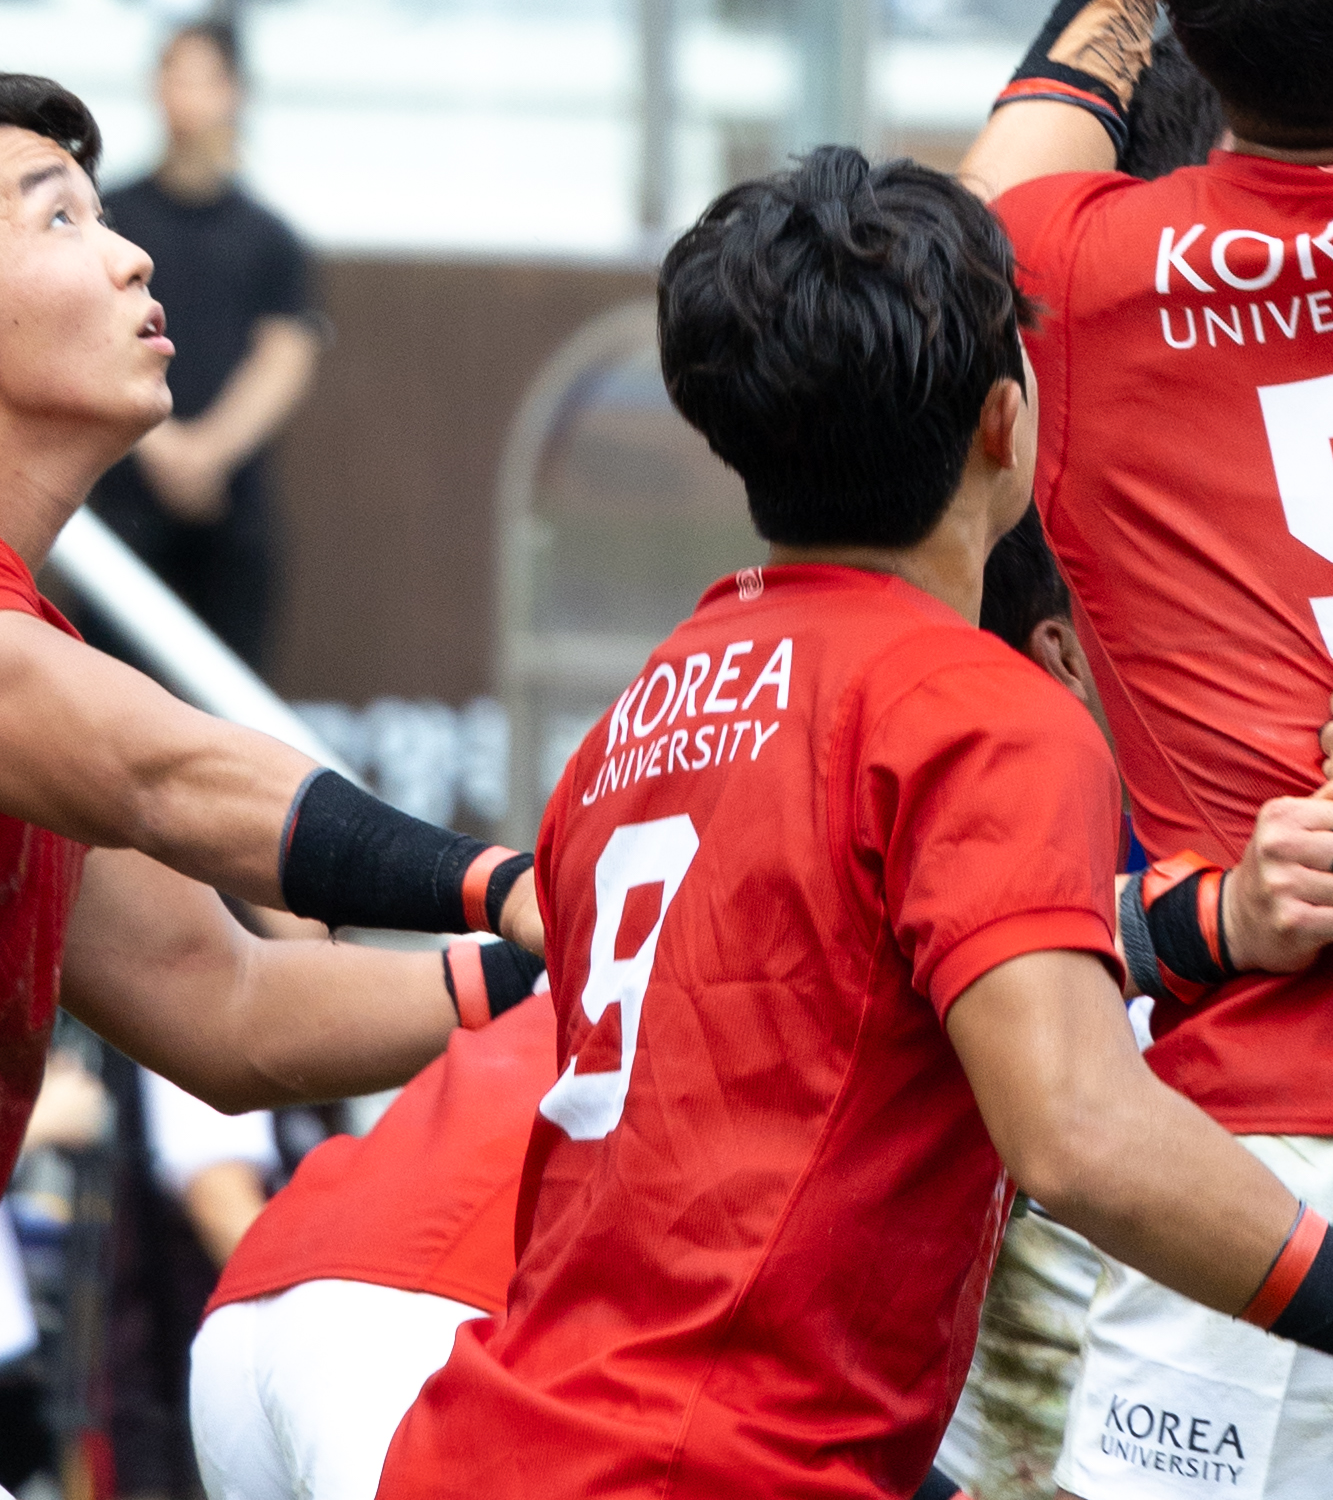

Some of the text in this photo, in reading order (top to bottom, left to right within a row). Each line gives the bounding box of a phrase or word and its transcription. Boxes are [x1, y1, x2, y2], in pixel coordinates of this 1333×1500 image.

[605, 638, 793, 757] KOREA
[582, 720, 780, 806] UNIVERSITY
[539, 813, 699, 1140] 9
[1101, 1435, 1244, 1486] UNIVERSITY
[1105, 1394, 1246, 1460] KOREA
